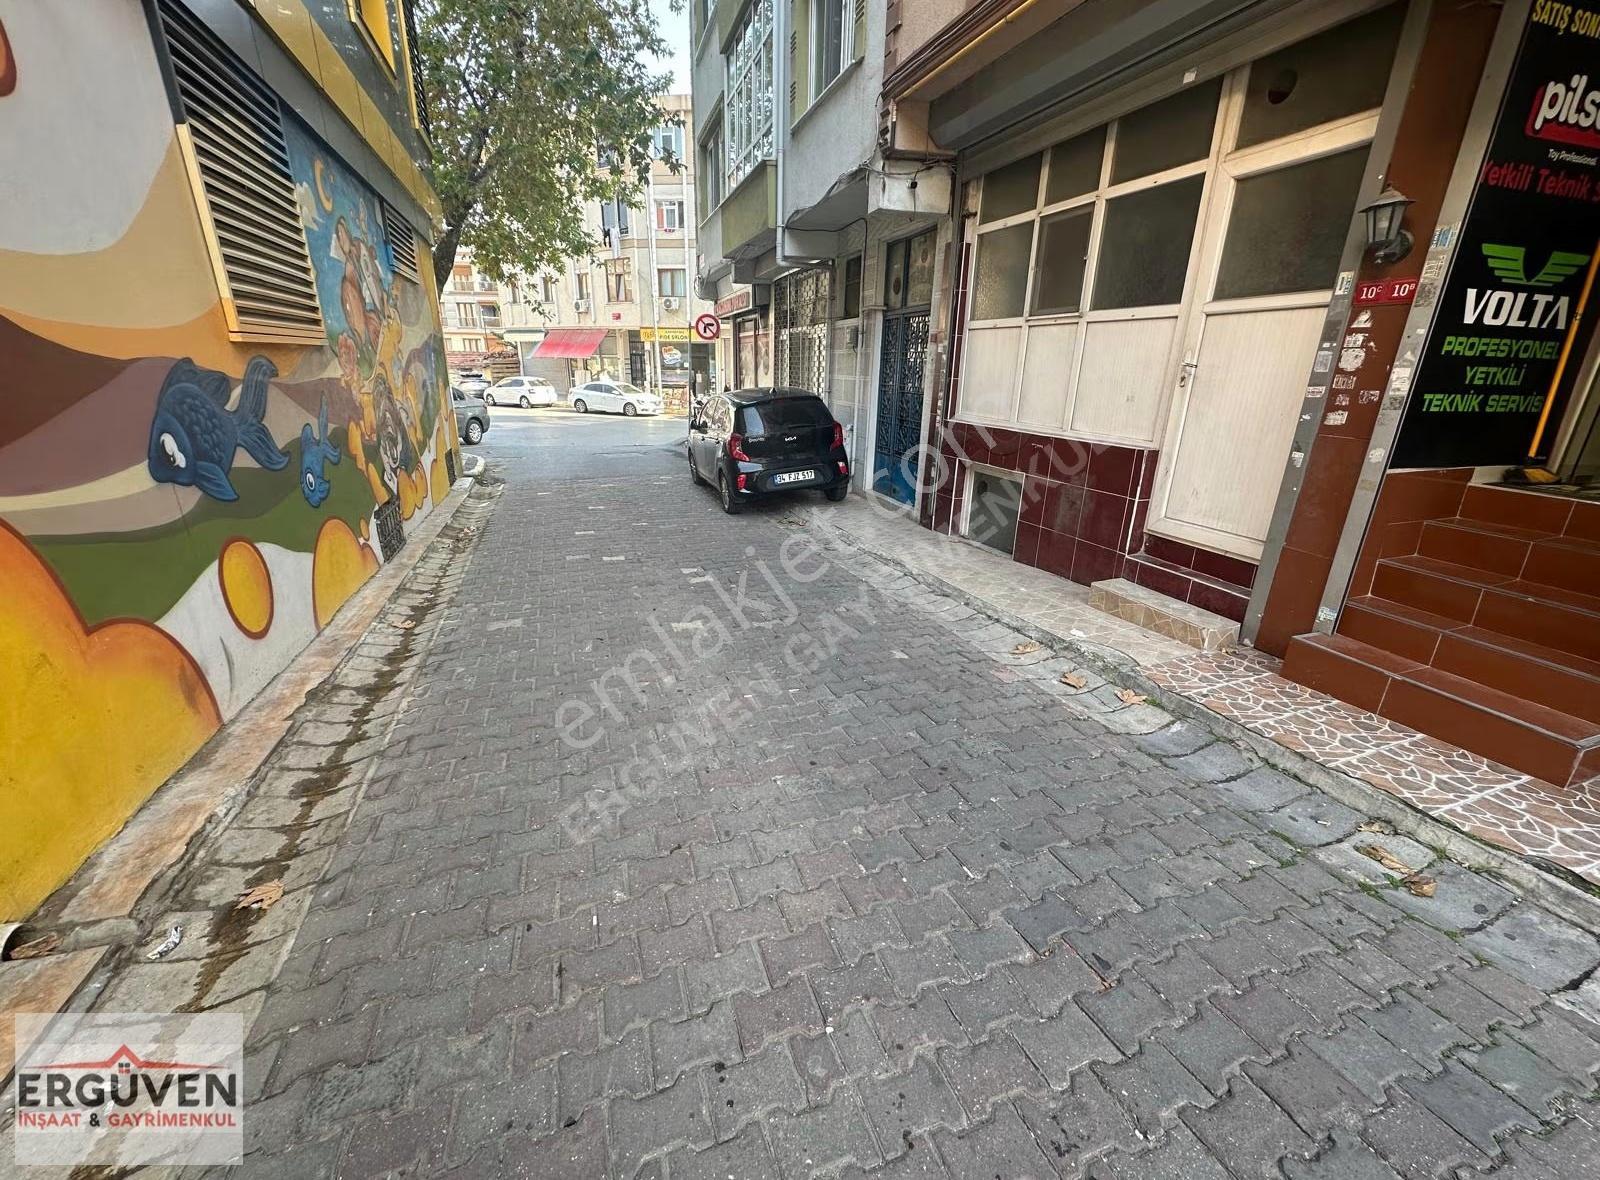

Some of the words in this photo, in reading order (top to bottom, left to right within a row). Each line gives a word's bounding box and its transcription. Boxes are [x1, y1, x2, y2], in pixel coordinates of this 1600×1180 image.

[1532, 0, 1572, 35] SATIŞ
[1571, 9, 1600, 39] SON
[1534, 74, 1600, 130] pils
[1481, 160, 1535, 191] Yetkili
[1536, 168, 1591, 199] Teknik
[1463, 288, 1570, 330] VOLTA
[1441, 335, 1560, 360] PROFESYONEL
[1465, 363, 1528, 386] YETKİLİ
[1422, 389, 1484, 412] TEKNİK
[1485, 391, 1544, 413] SERVİS
[801, 470, 813, 479] 517
